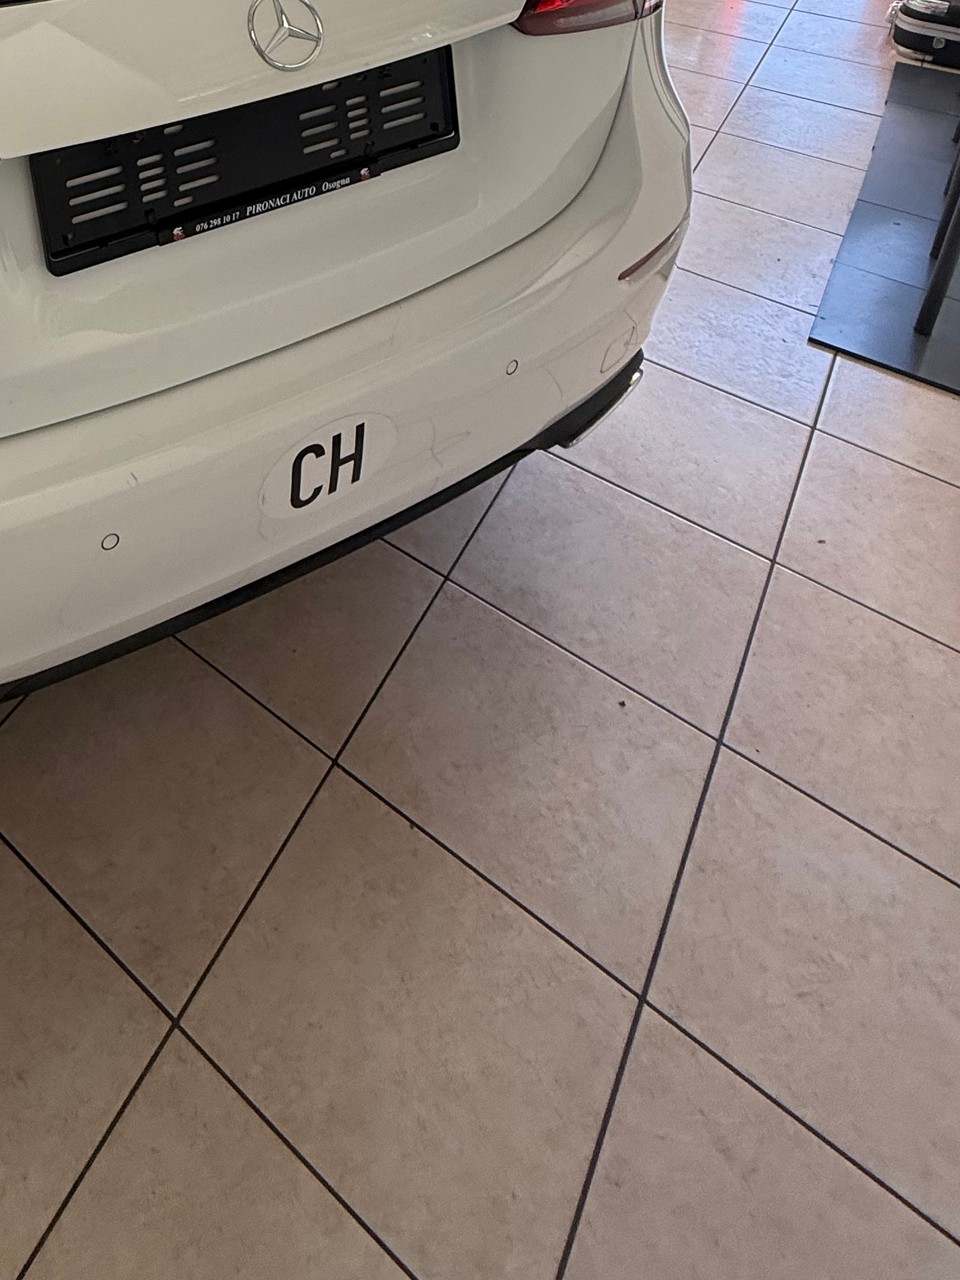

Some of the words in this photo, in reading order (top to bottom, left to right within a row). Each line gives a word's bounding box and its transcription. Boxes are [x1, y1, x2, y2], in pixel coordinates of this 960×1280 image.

[195, 221, 209, 232] 076
[209, 217, 222, 228] 298
[223, 214, 231, 224] 10
[231, 211, 240, 221] 17
[246, 194, 290, 216] PIRONACI
[291, 185, 317, 202] AUTO
[321, 177, 350, 192] Osogna
[290, 422, 365, 509] CH
